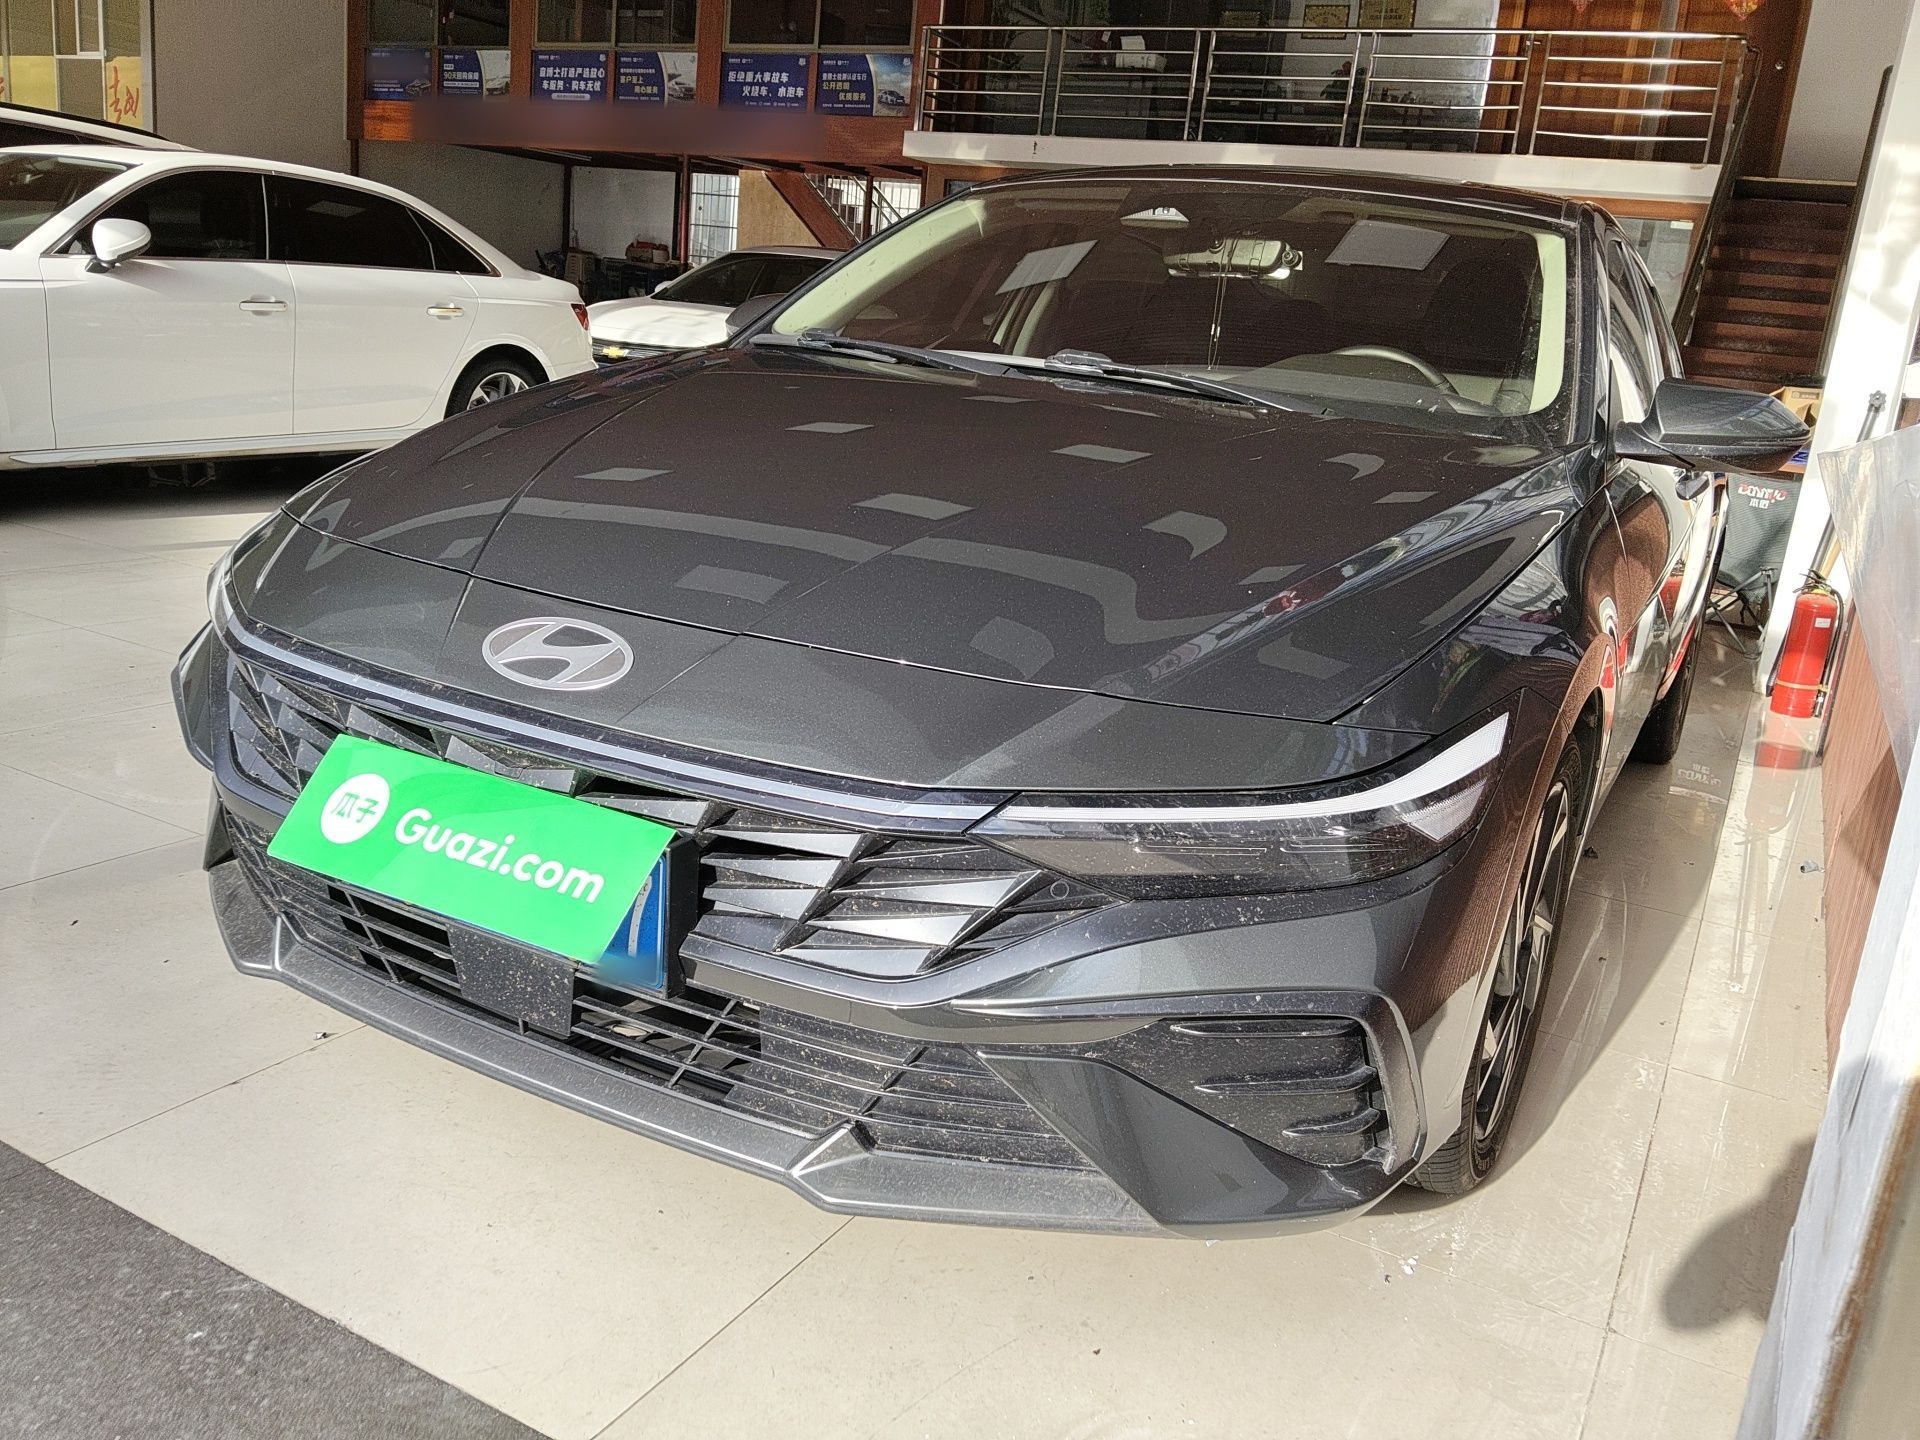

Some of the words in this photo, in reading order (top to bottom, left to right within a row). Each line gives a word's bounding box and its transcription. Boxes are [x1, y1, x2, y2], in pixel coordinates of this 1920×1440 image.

[728, 71, 789, 83] 拒绝重大事故车
